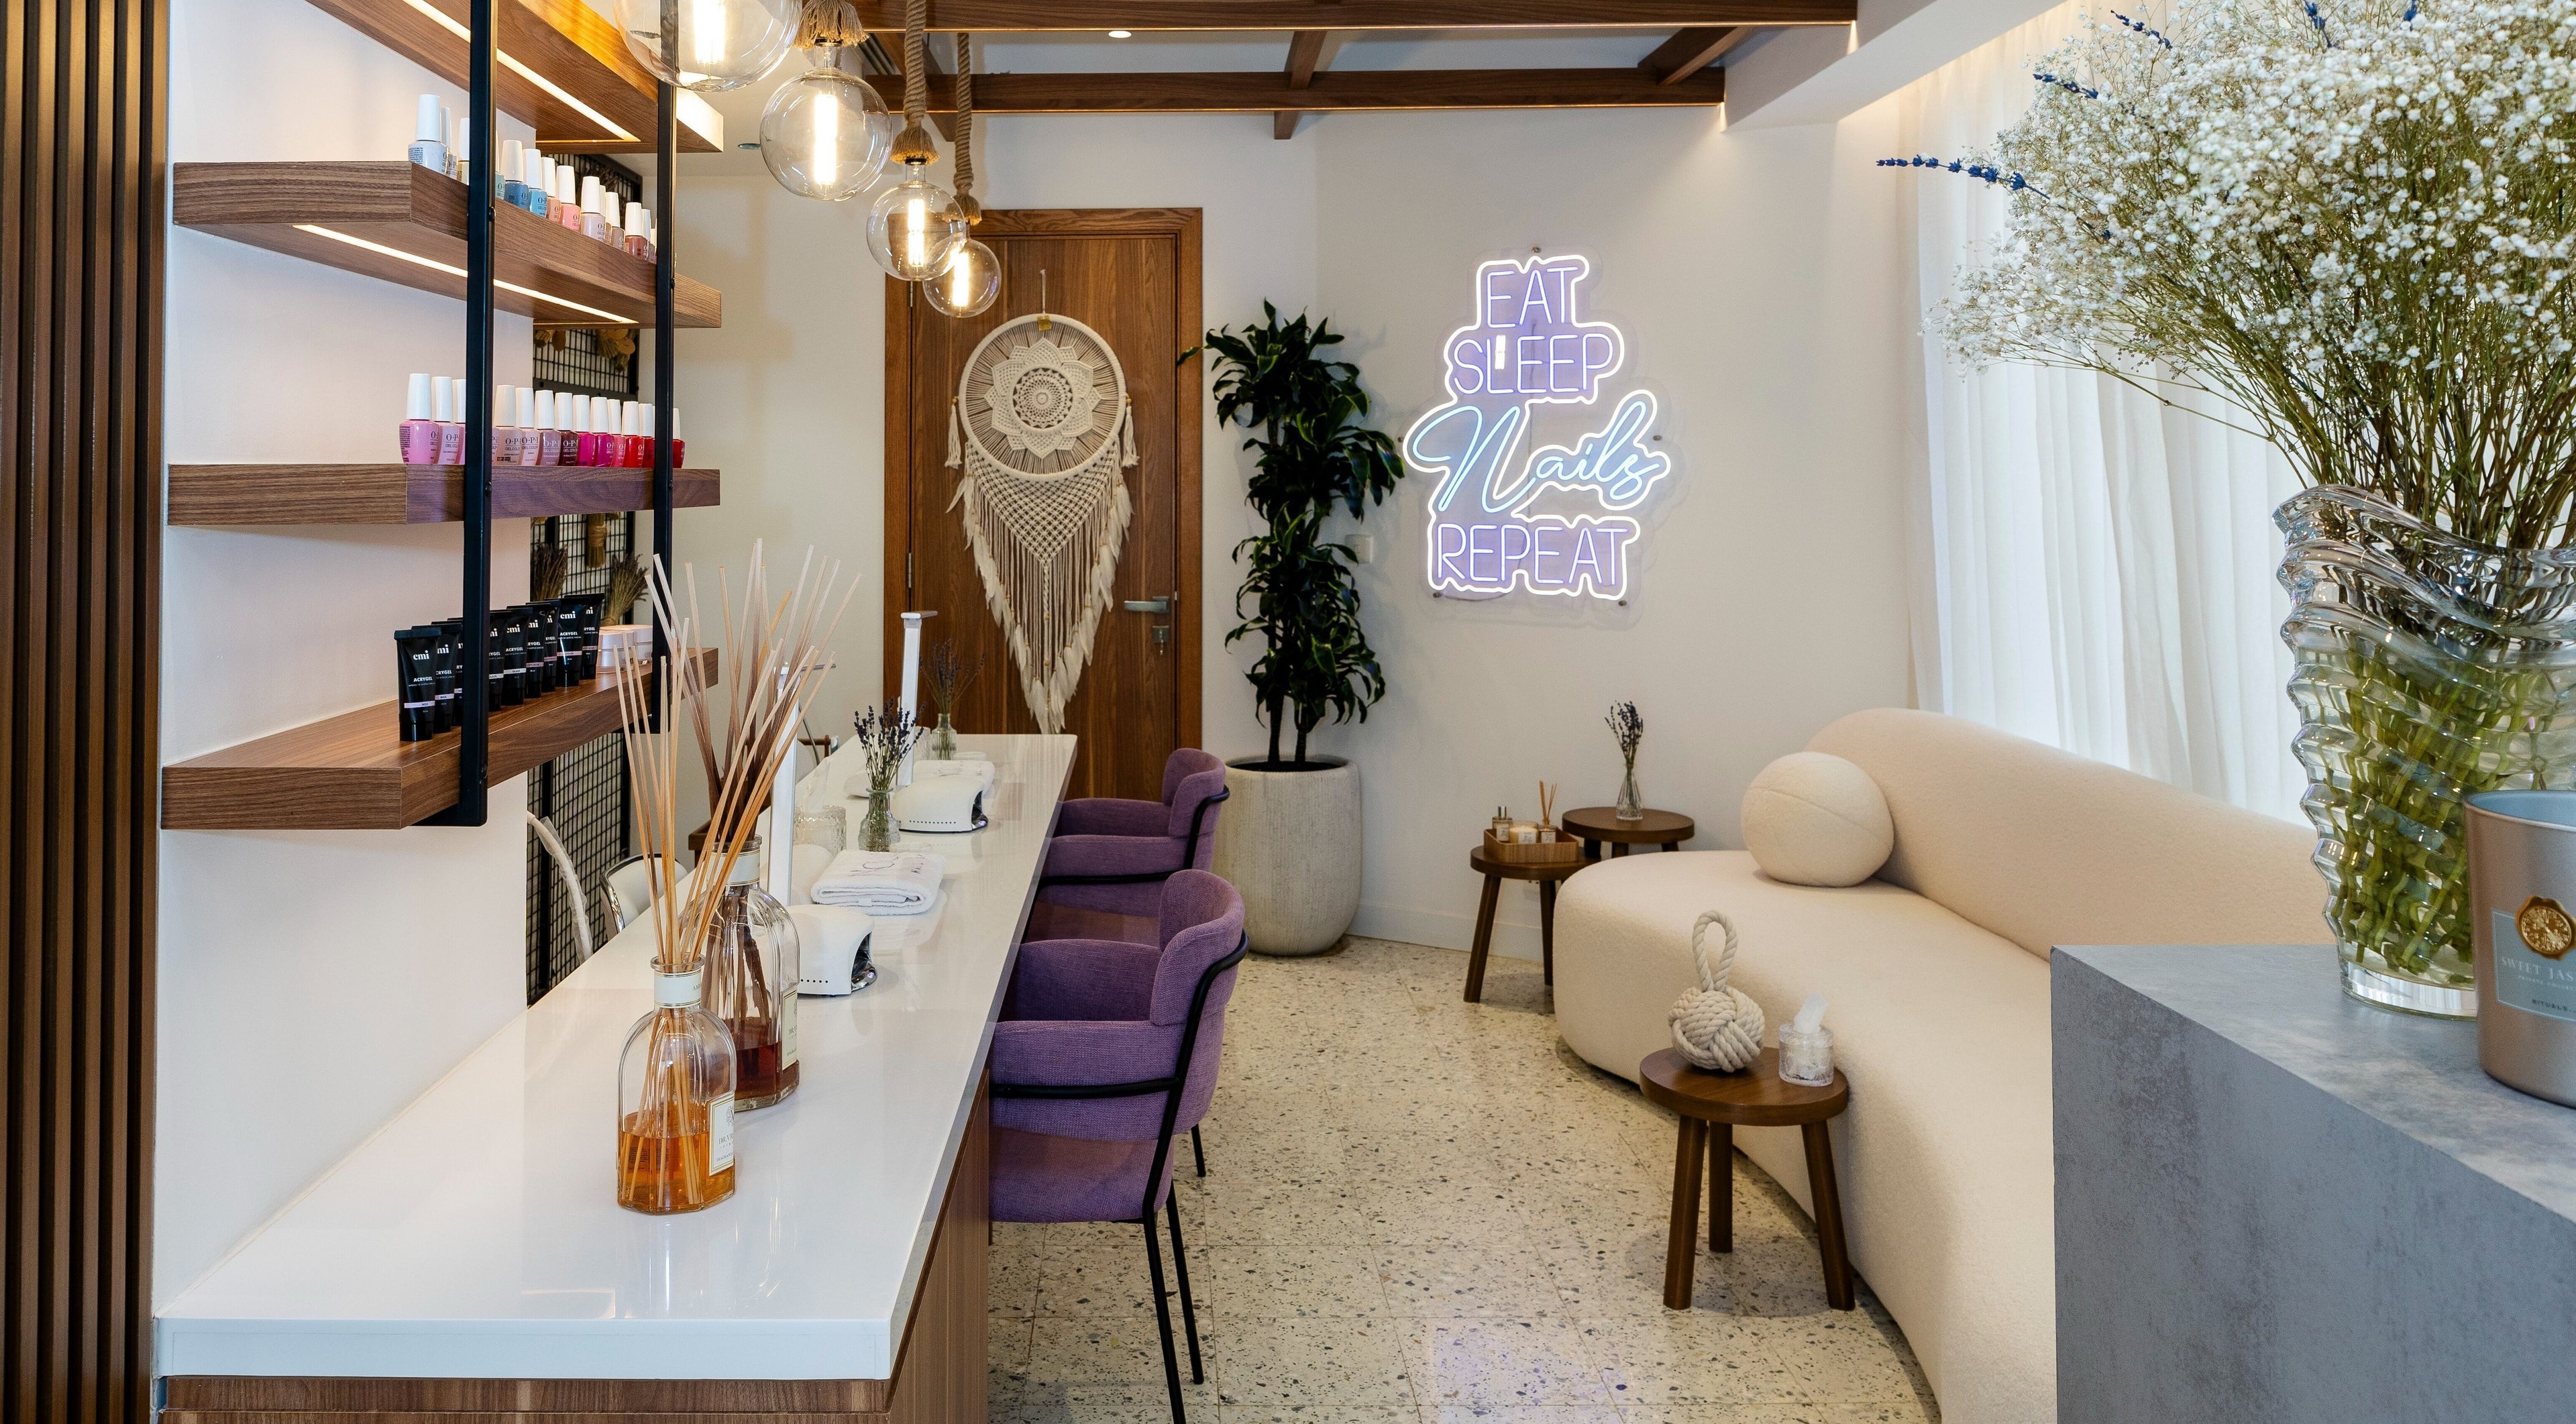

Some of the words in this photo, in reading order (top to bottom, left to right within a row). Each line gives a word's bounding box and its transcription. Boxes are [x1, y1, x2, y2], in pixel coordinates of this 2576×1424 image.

[1487, 266, 1580, 329] EAT
[1454, 333, 1613, 394] SLEEP
[1412, 400, 1660, 514] Nails
[1437, 523, 1630, 585] REPEAT
[528, 619, 539, 628] mi
[560, 610, 576, 619] emi
[413, 650, 429, 661] emi
[437, 644, 449, 654] mi
